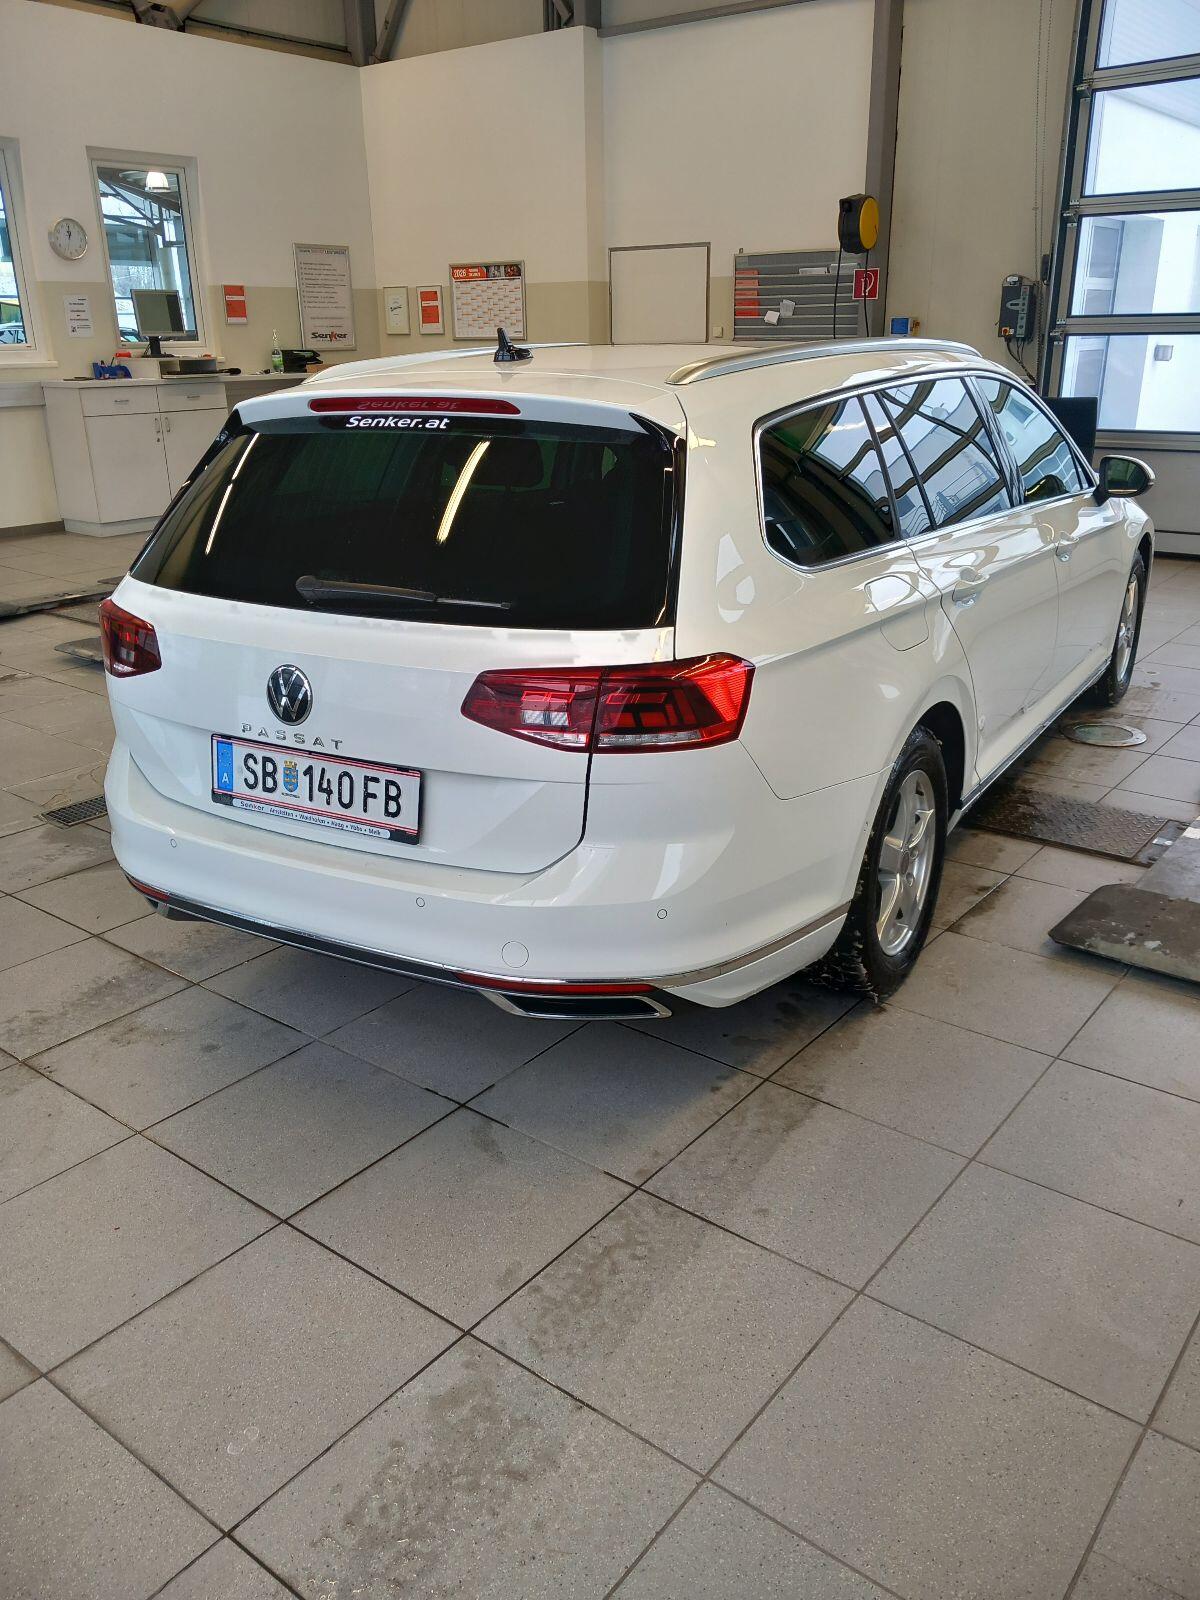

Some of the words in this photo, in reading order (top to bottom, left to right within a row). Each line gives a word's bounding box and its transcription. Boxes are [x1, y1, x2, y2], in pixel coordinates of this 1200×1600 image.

[311, 331, 348, 342] Senker
[346, 416, 450, 429] Senker.at
[241, 723, 343, 750] PASSAT
[221, 772, 230, 784] A
[243, 753, 278, 793] SB
[240, 800, 265, 812] Senker
